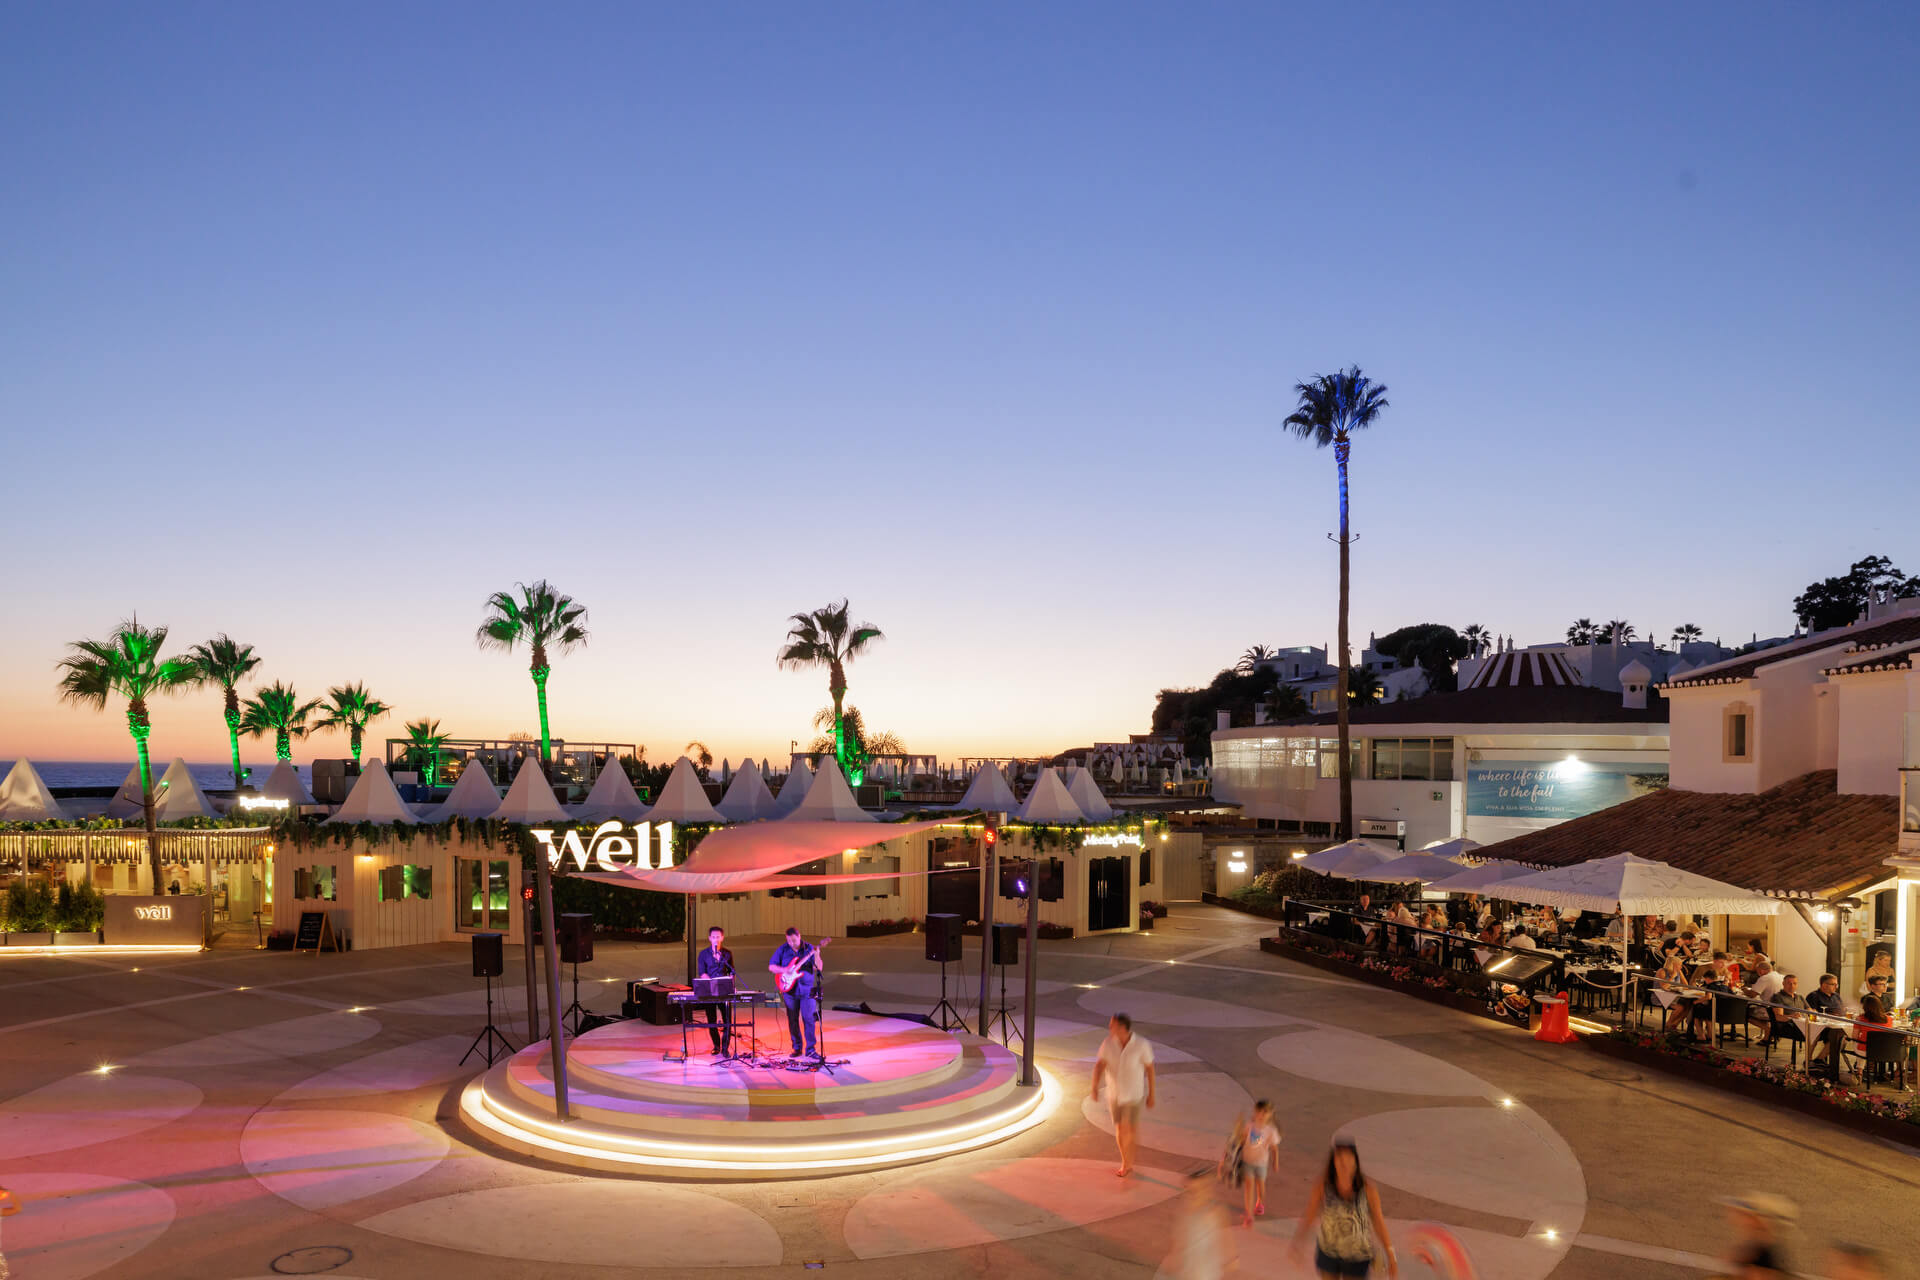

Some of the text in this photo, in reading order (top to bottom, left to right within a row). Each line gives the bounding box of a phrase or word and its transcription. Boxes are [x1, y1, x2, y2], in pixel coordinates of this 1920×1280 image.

[1478, 769, 1512, 782] where
[1512, 768, 1532, 786] life
[1498, 786, 1509, 797] to
[1510, 785, 1530, 797] the
